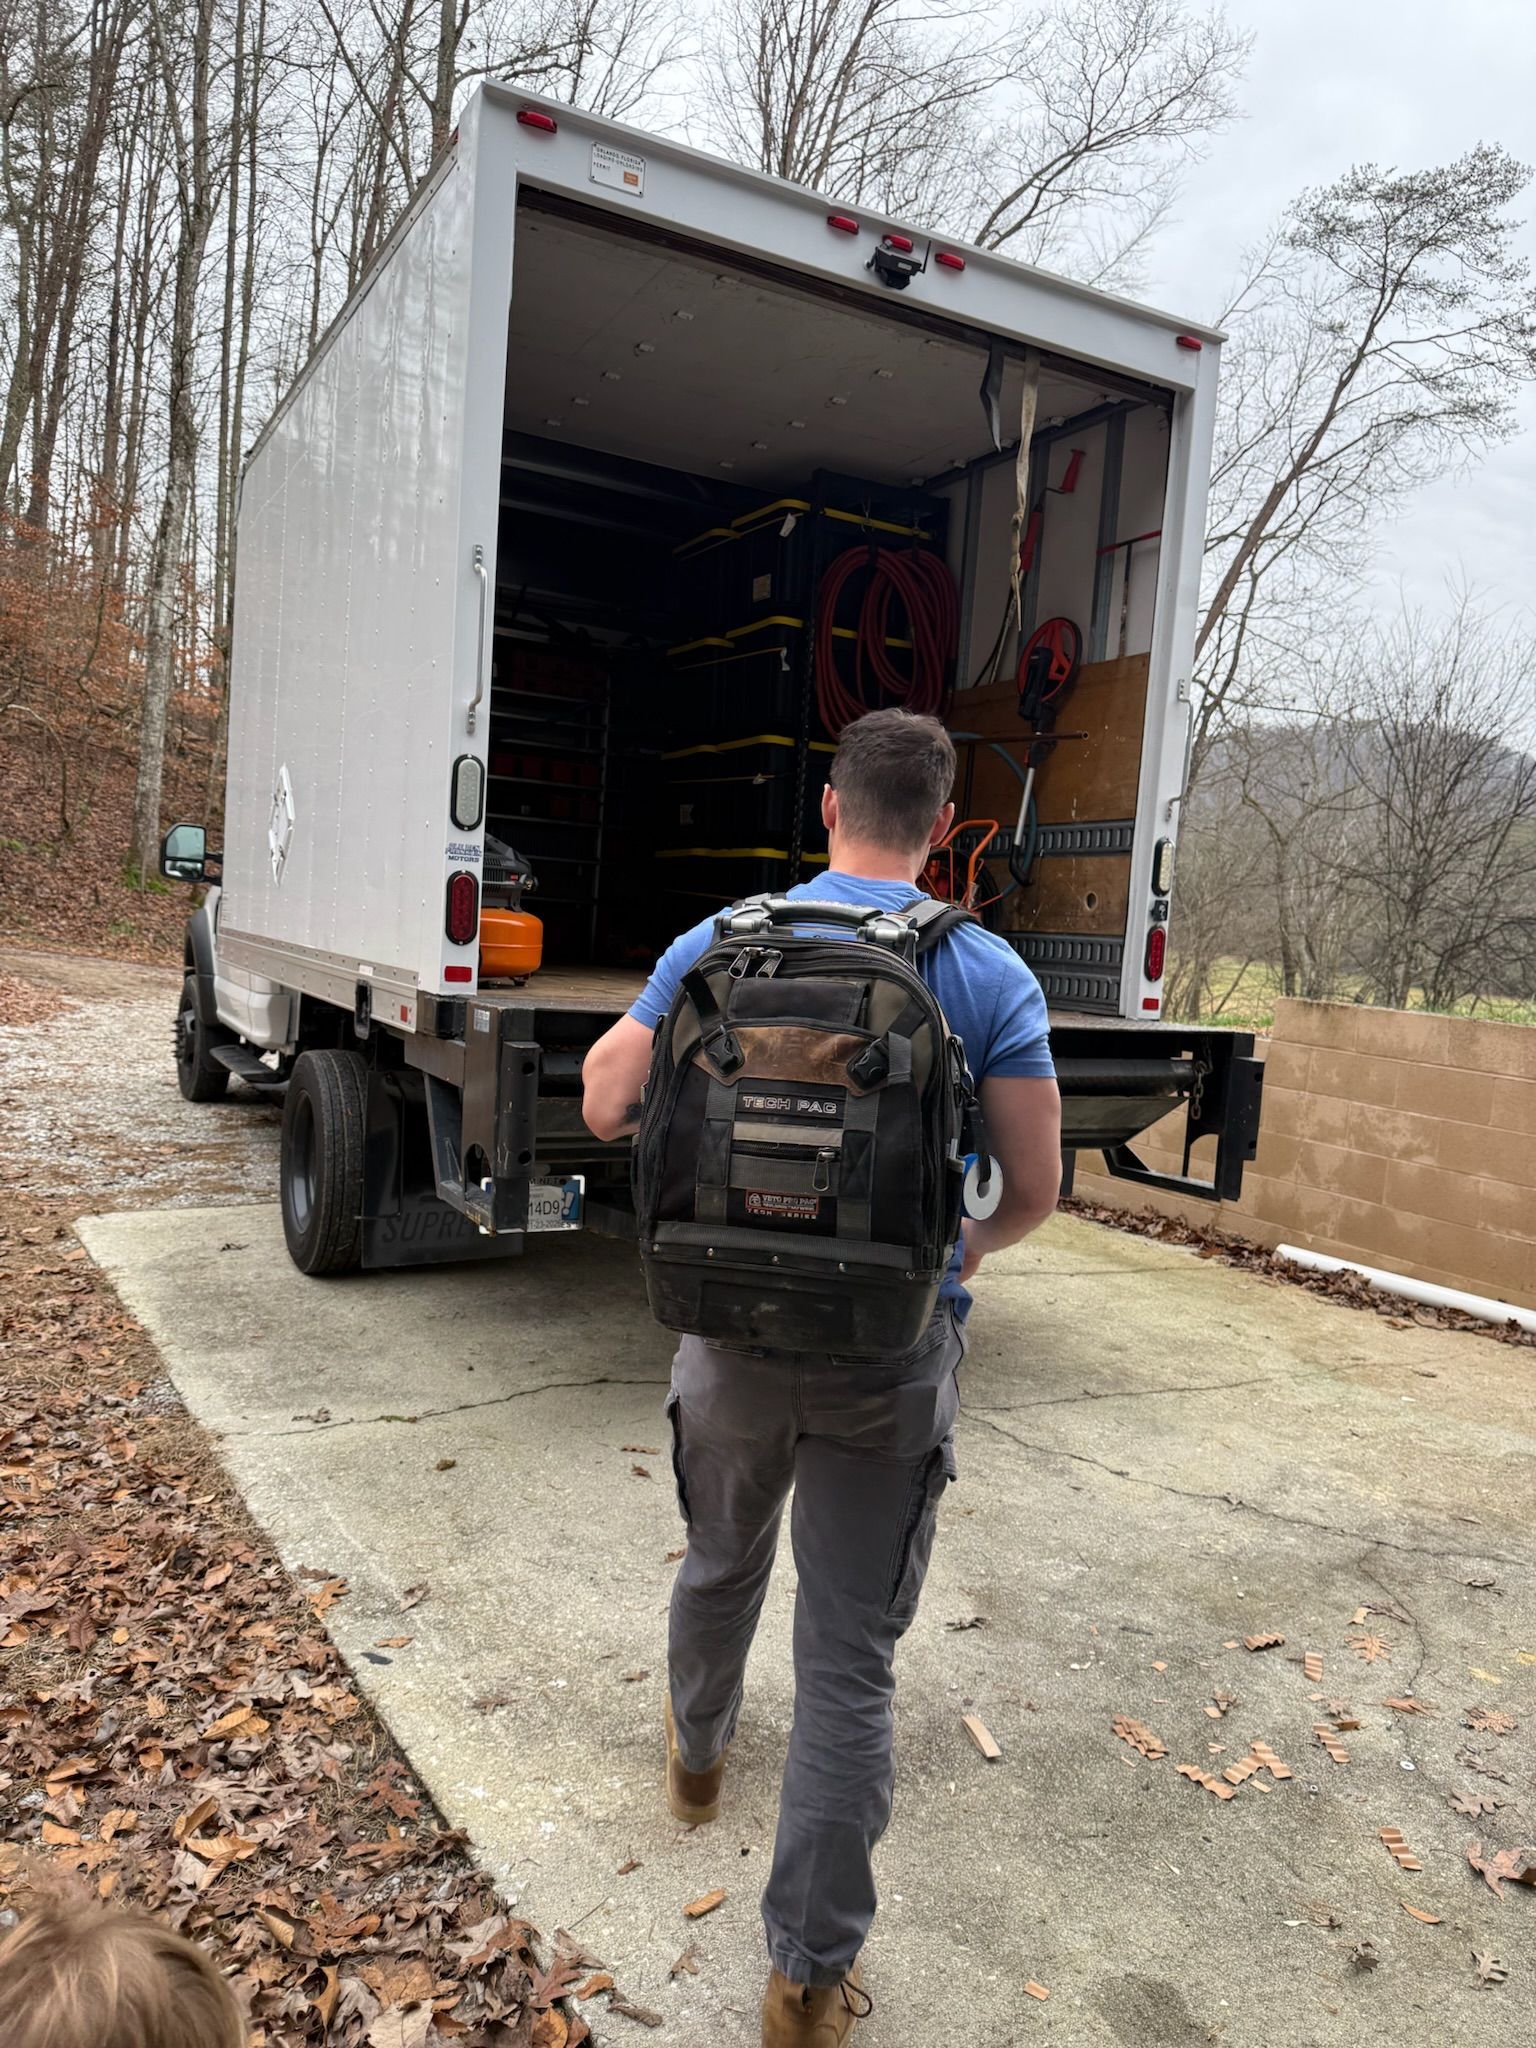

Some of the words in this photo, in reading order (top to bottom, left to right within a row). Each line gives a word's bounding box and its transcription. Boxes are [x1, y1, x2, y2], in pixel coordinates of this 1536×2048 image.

[448, 855, 480, 863] MOTORS
[743, 1096, 791, 1110] TECH
[797, 1100, 837, 1114] PAC
[762, 1194, 782, 1203] VETO
[747, 1208, 772, 1216] TECH
